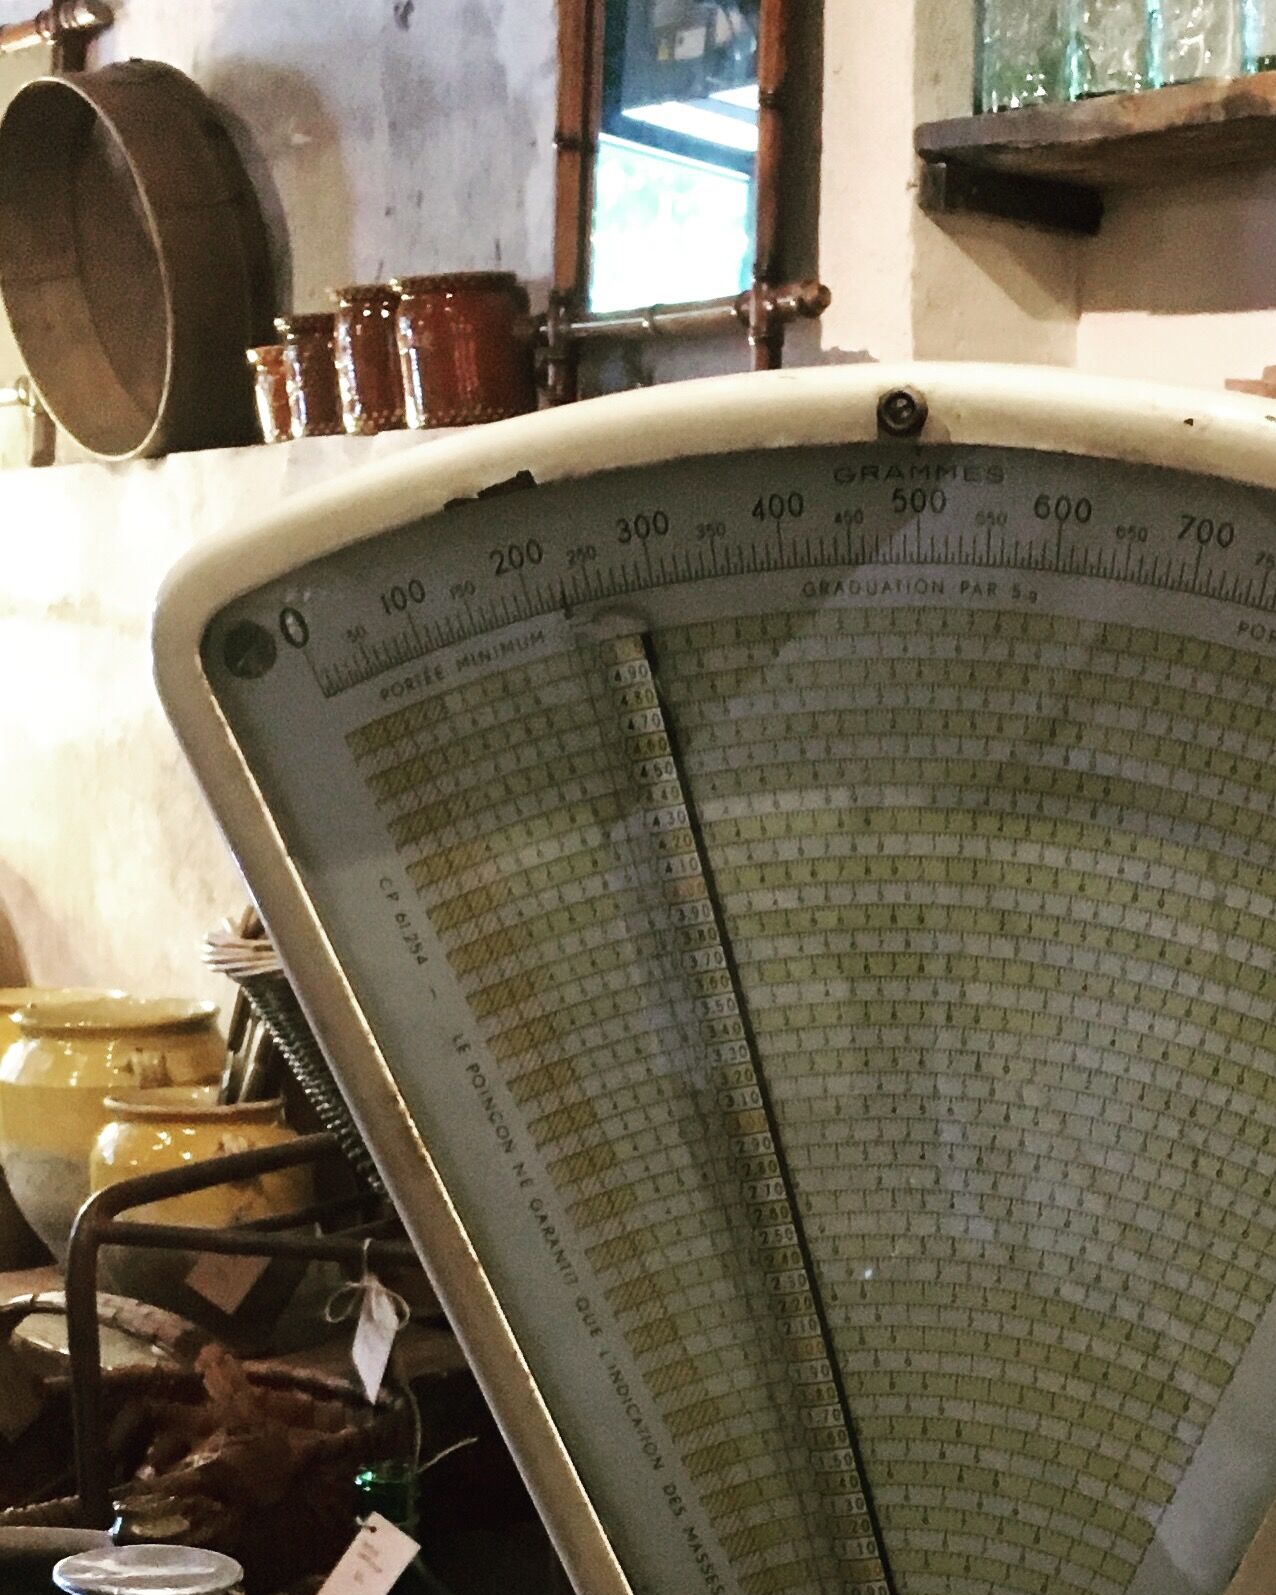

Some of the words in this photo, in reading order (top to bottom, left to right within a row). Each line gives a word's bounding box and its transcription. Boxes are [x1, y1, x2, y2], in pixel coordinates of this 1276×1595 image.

[834, 464, 1004, 484] GRAMMES
[279, 607, 309, 649] 0
[381, 579, 426, 616] 100
[489, 538, 544, 576] 200
[616, 510, 670, 544] 300
[752, 491, 804, 522] 400
[891, 488, 947, 515] 500
[1033, 493, 1093, 524] 600
[1177, 513, 1235, 549] 700
[801, 578, 945, 599] GRADUATION
[959, 580, 998, 597] PAR
[455, 629, 546, 672] MINIMUM
[451, 1033, 470, 1055] LE
[512, 1161, 531, 1190] NE
[575, 1298, 603, 1338] QUE
[662, 1483, 686, 1517] DES
